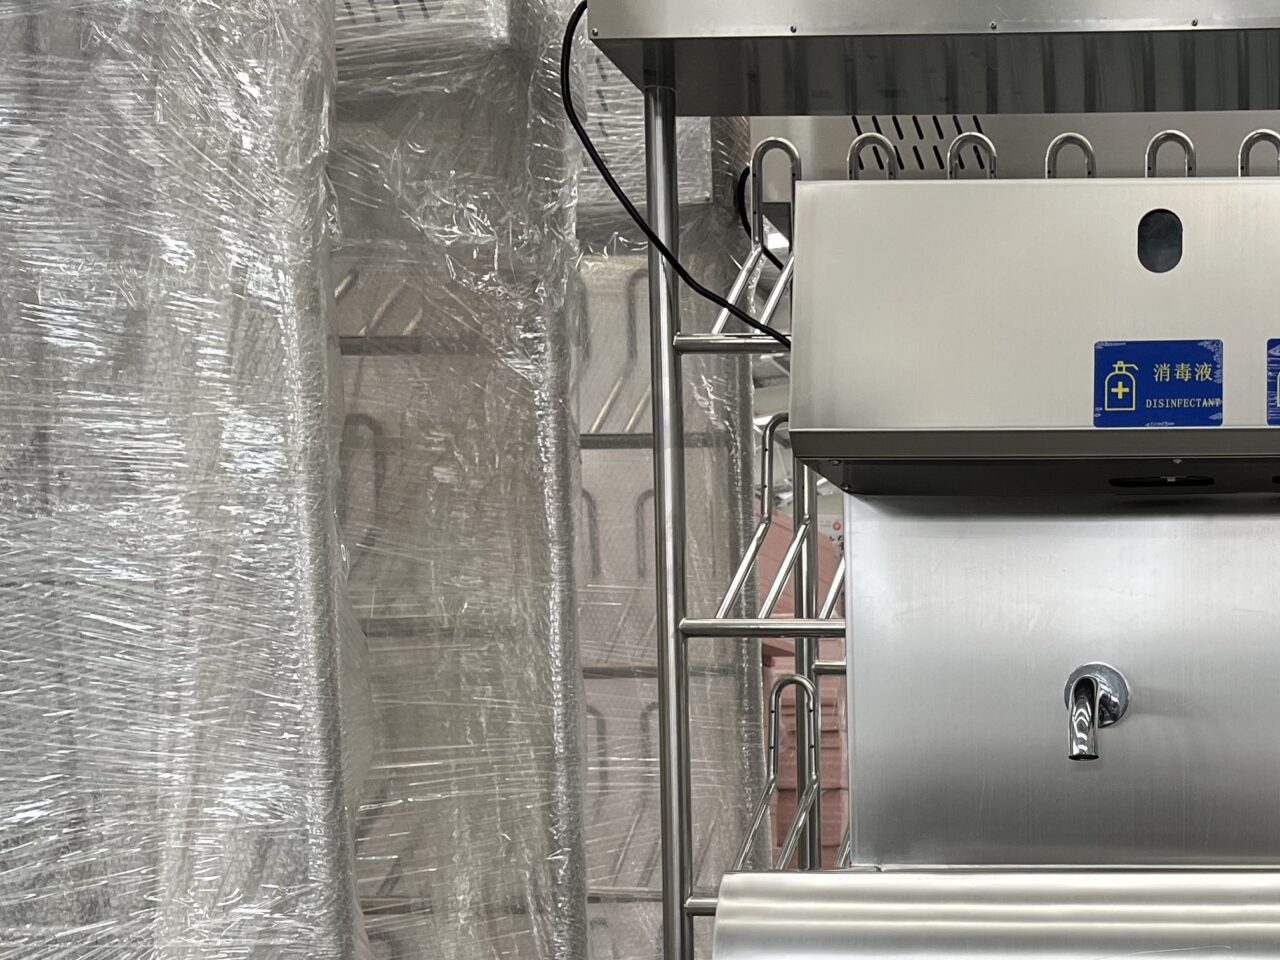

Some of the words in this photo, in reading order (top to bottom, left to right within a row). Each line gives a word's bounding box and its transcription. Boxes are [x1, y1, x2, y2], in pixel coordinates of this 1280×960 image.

[1153, 361, 1213, 382] 消毒液
[1145, 397, 1221, 409] DISINFECTANT
